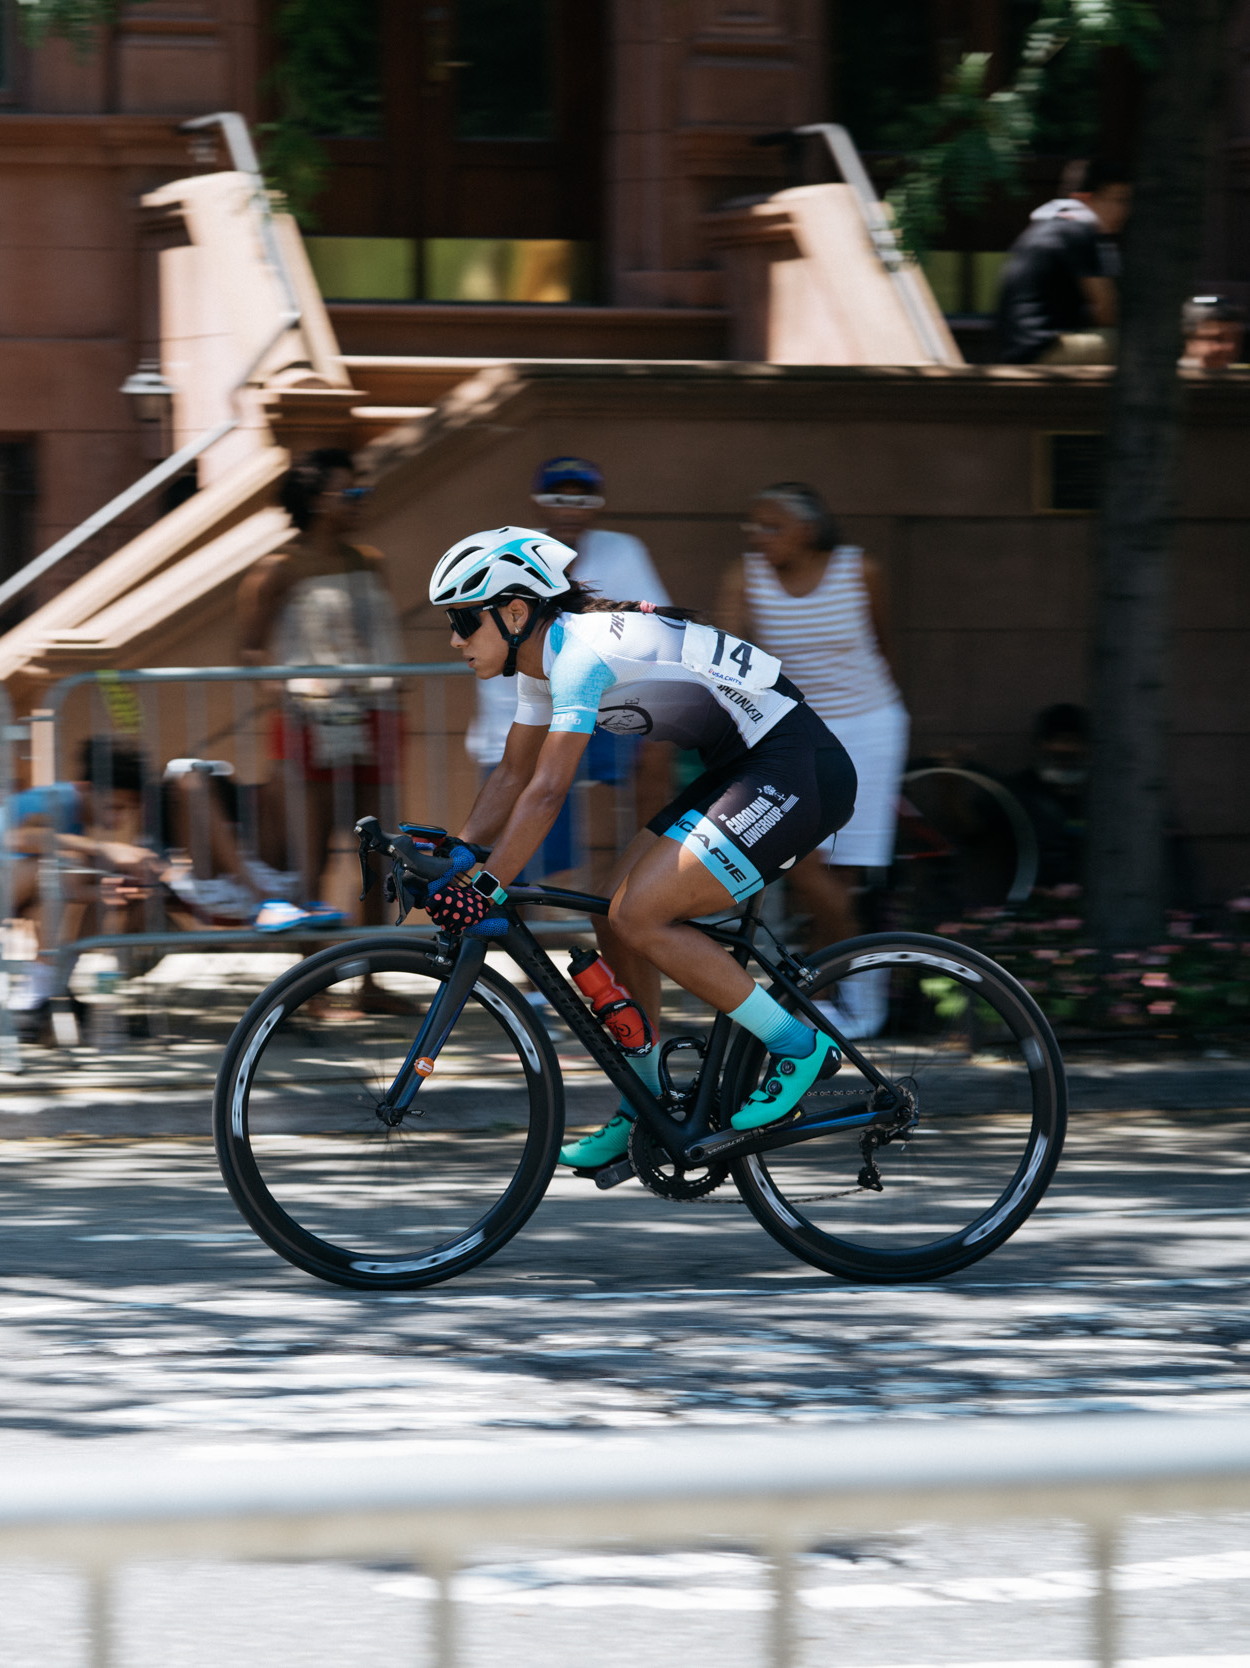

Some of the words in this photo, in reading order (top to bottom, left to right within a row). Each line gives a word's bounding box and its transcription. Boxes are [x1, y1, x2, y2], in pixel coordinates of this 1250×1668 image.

[610, 613, 625, 640] THE
[712, 630, 753, 678] 14
[725, 796, 774, 836] CAROLINA
